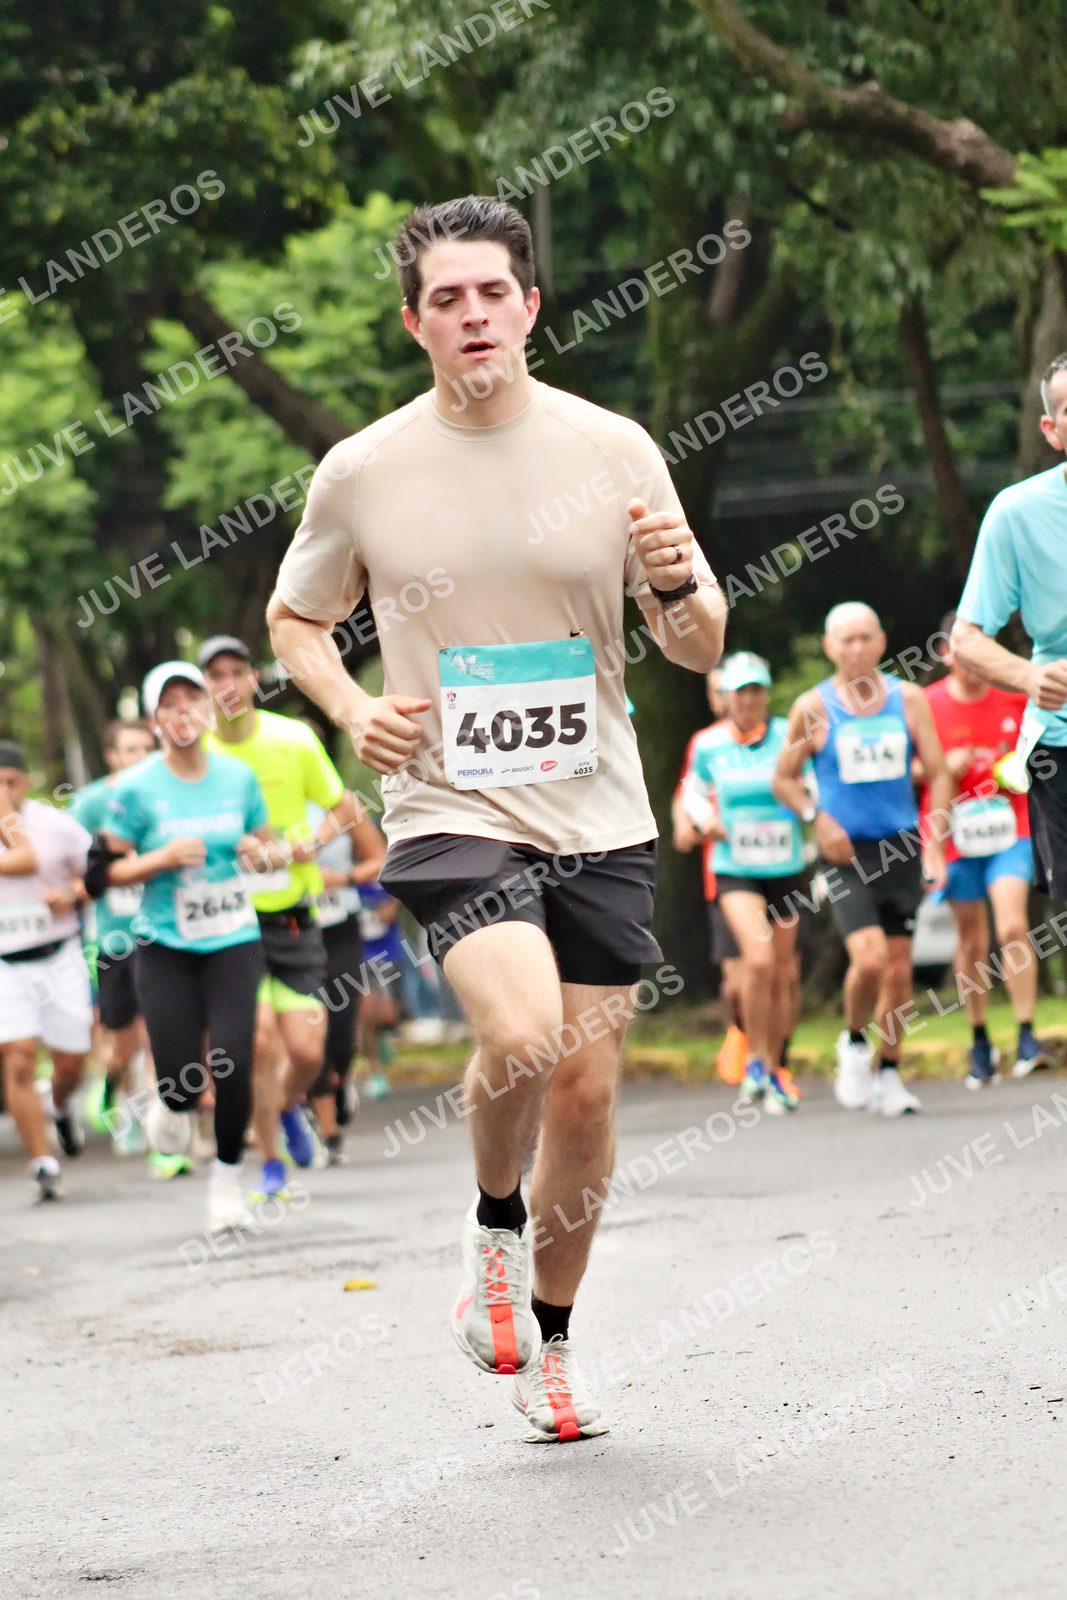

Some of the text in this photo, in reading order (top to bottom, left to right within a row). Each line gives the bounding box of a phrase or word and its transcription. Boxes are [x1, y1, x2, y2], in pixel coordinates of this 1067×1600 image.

[456, 702, 587, 753] 4035
[457, 768, 493, 777] PERDURA
[511, 765, 534, 773] BROOKS
[574, 766, 593, 775] 4035
